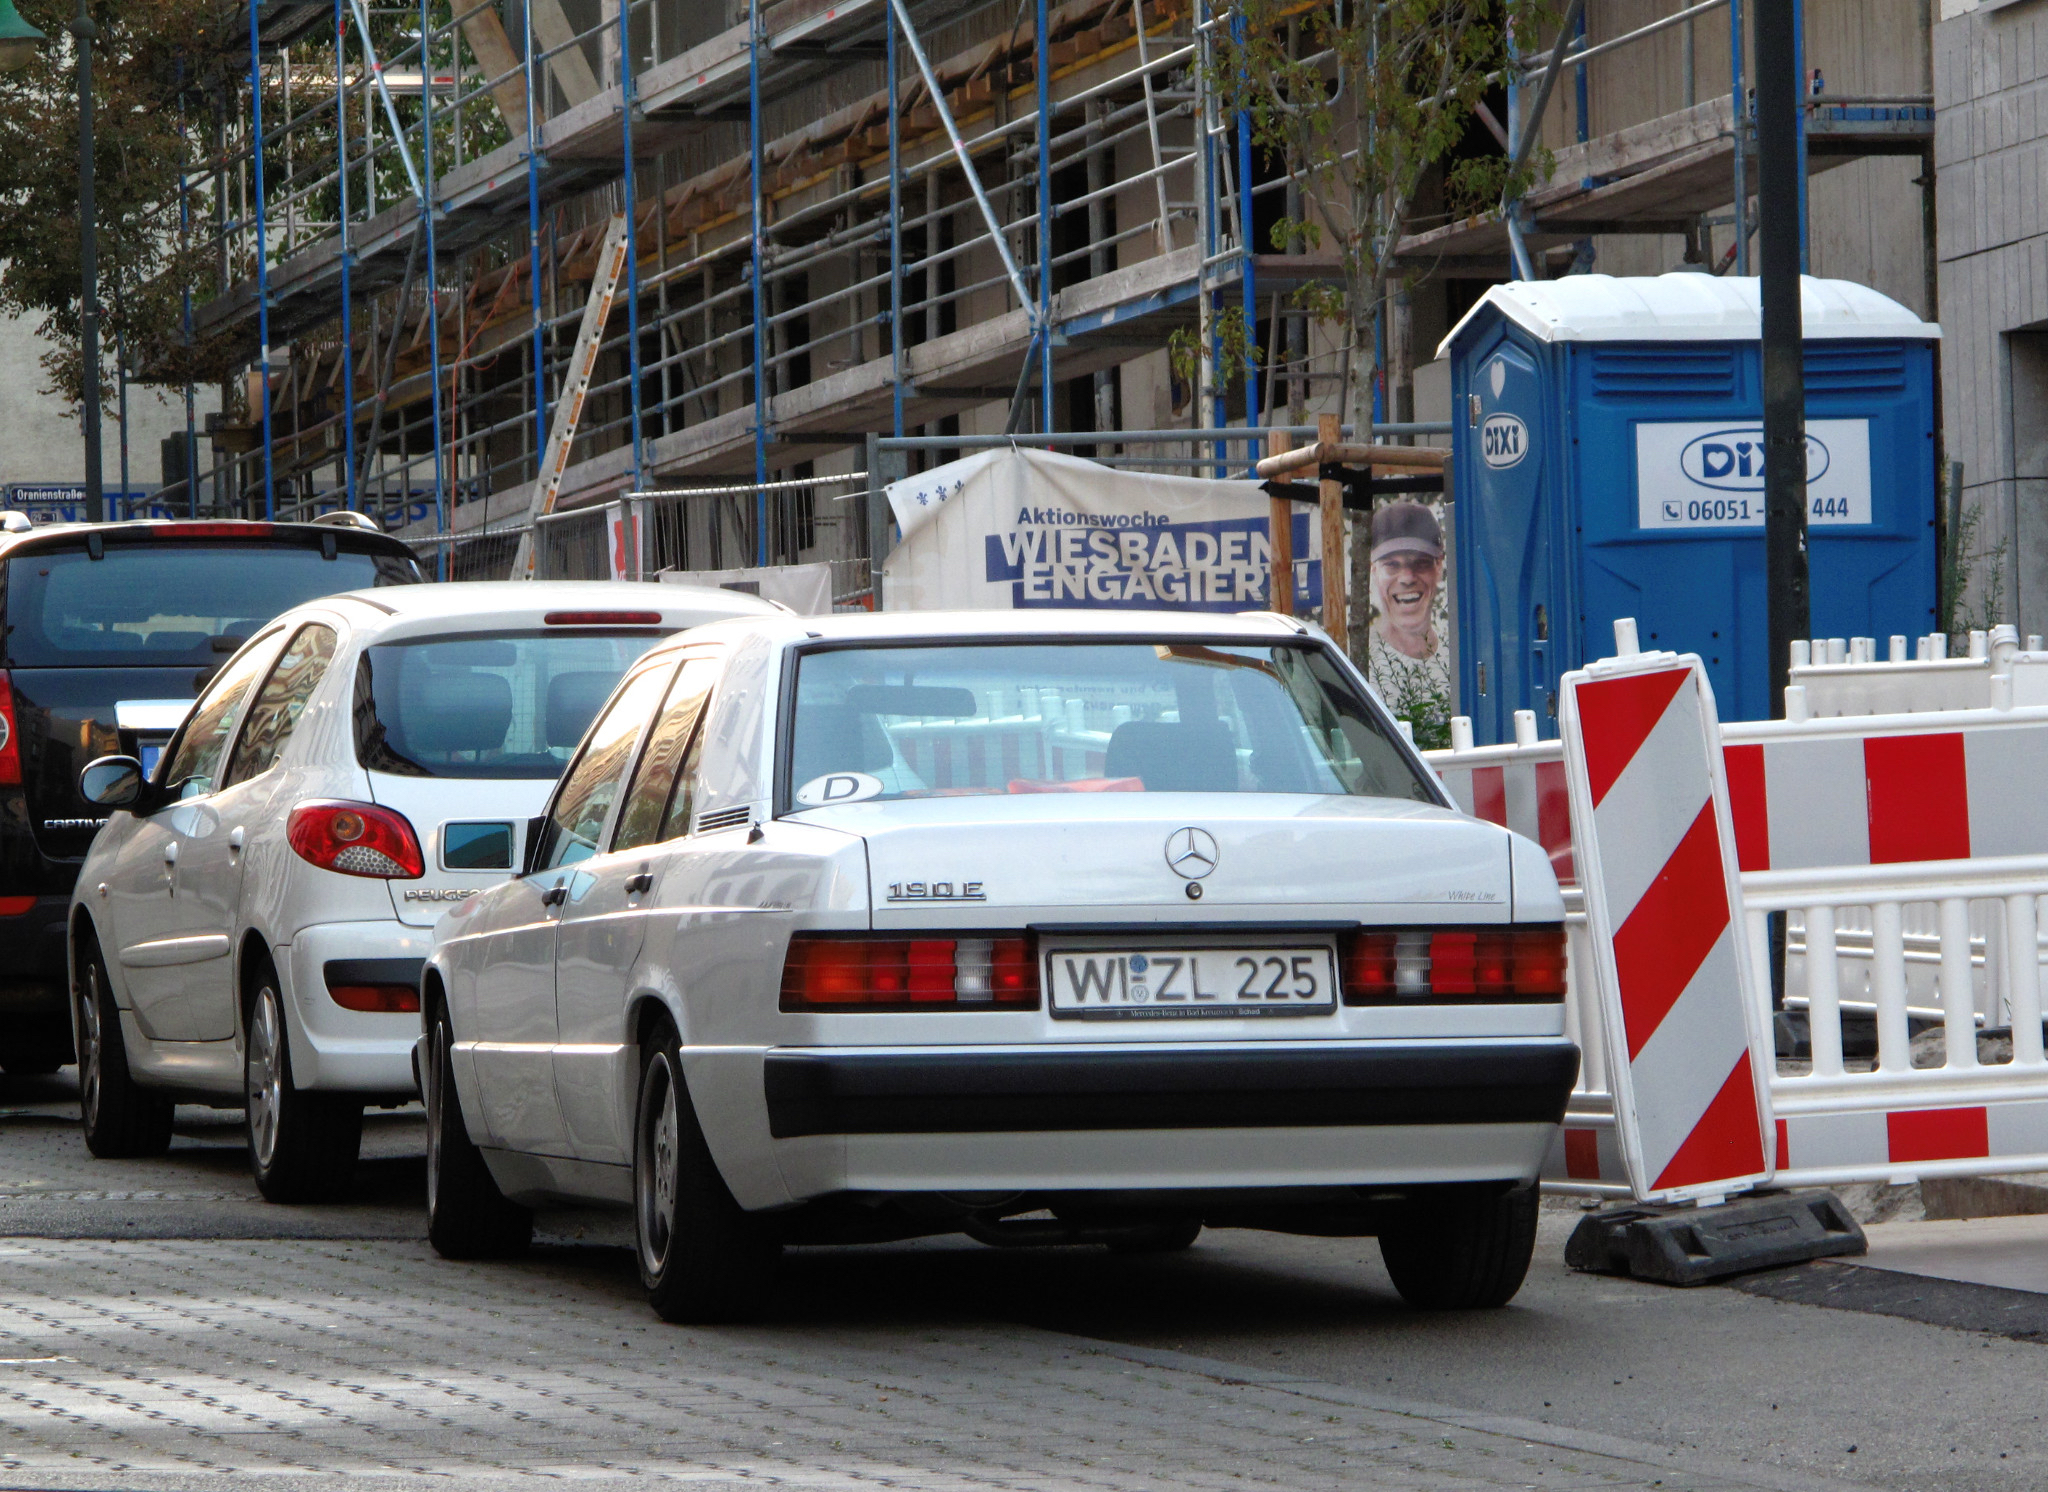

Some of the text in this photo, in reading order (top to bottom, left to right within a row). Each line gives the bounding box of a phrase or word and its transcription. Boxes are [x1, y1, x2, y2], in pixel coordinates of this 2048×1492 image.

[17, 489, 83, 501] Oranienstraße
[1017, 507, 1170, 528] Aktionswoche
[1688, 500, 1750, 521] 06051
[1000, 529, 1272, 569] WIESBADEN
[1023, 562, 1310, 602] ENGAGIER!
[823, 776, 859, 801] D
[404, 888, 486, 902] PEUGE
[889, 882, 985, 898] 190 E
[1235, 956, 1317, 999] 225
